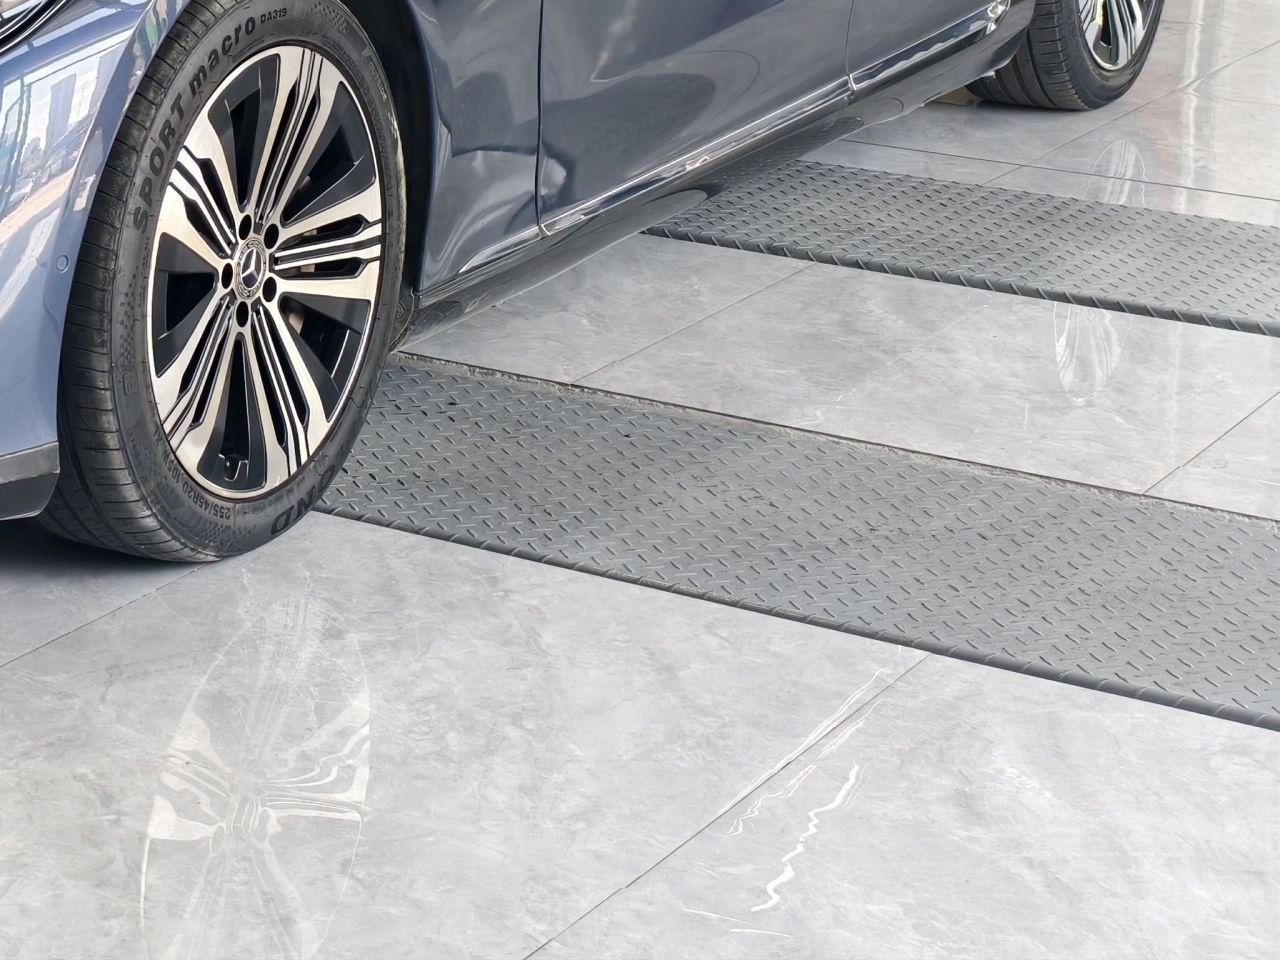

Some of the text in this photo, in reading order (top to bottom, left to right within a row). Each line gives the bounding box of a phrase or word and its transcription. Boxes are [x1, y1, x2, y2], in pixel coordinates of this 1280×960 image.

[133, 7, 288, 231] SPORT macro DA319
